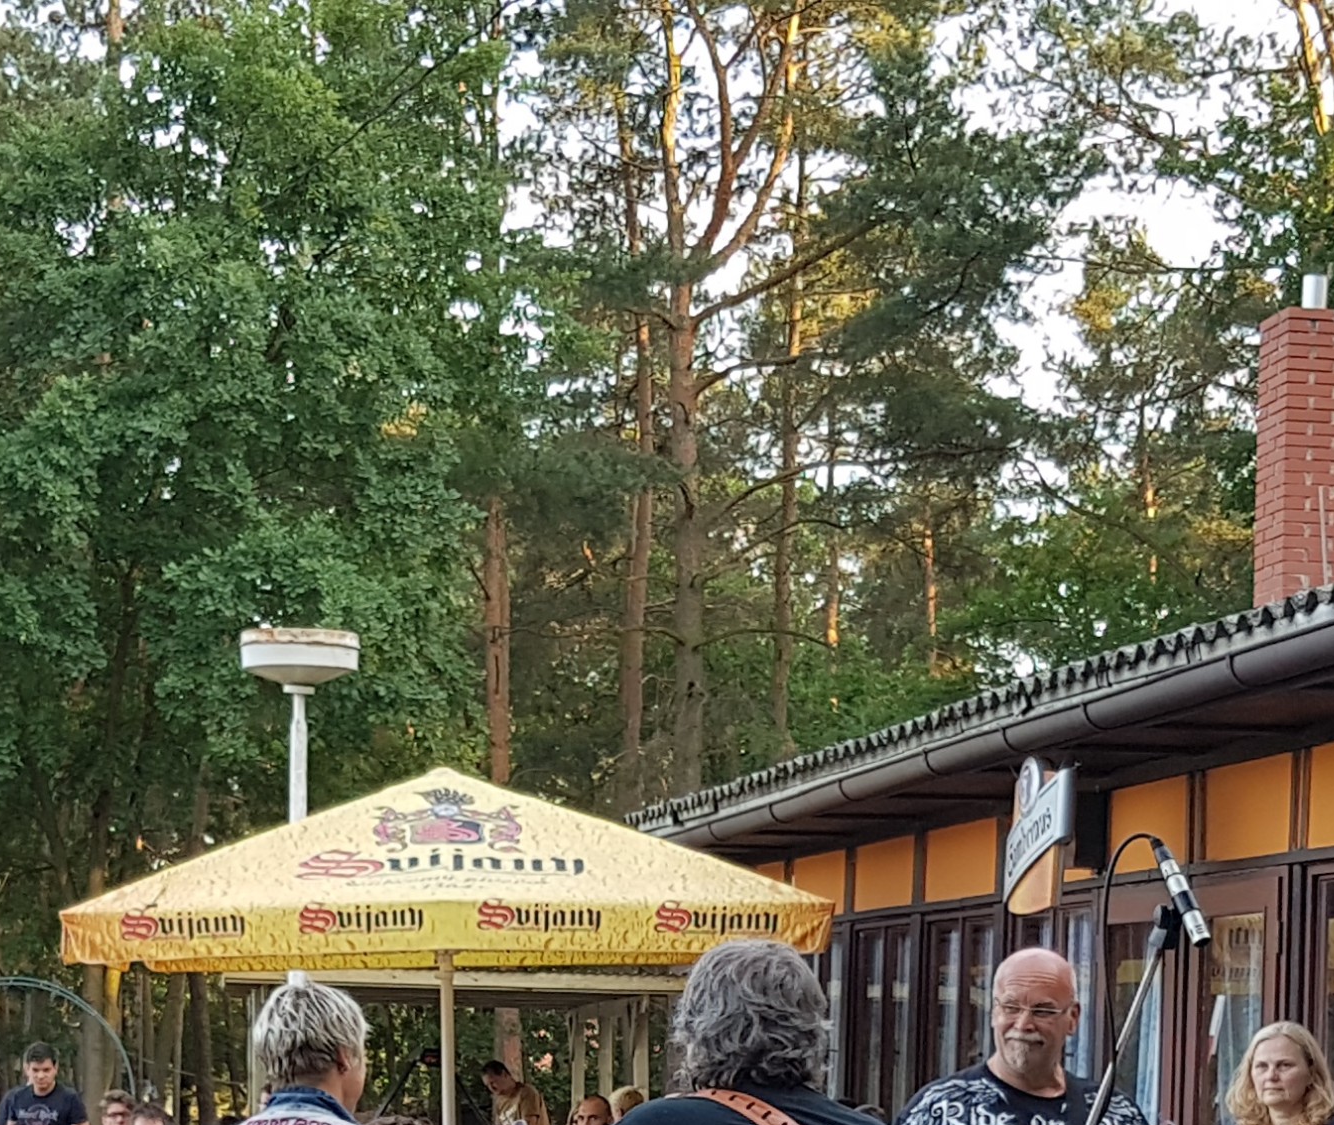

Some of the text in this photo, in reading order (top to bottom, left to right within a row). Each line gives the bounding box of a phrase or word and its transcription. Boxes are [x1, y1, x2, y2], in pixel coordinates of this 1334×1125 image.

[295, 848, 585, 880] Svijany
[120, 906, 246, 941] Svijany
[299, 901, 424, 934] Svijany
[477, 898, 602, 932] Svijany
[654, 899, 779, 935] Svijany
